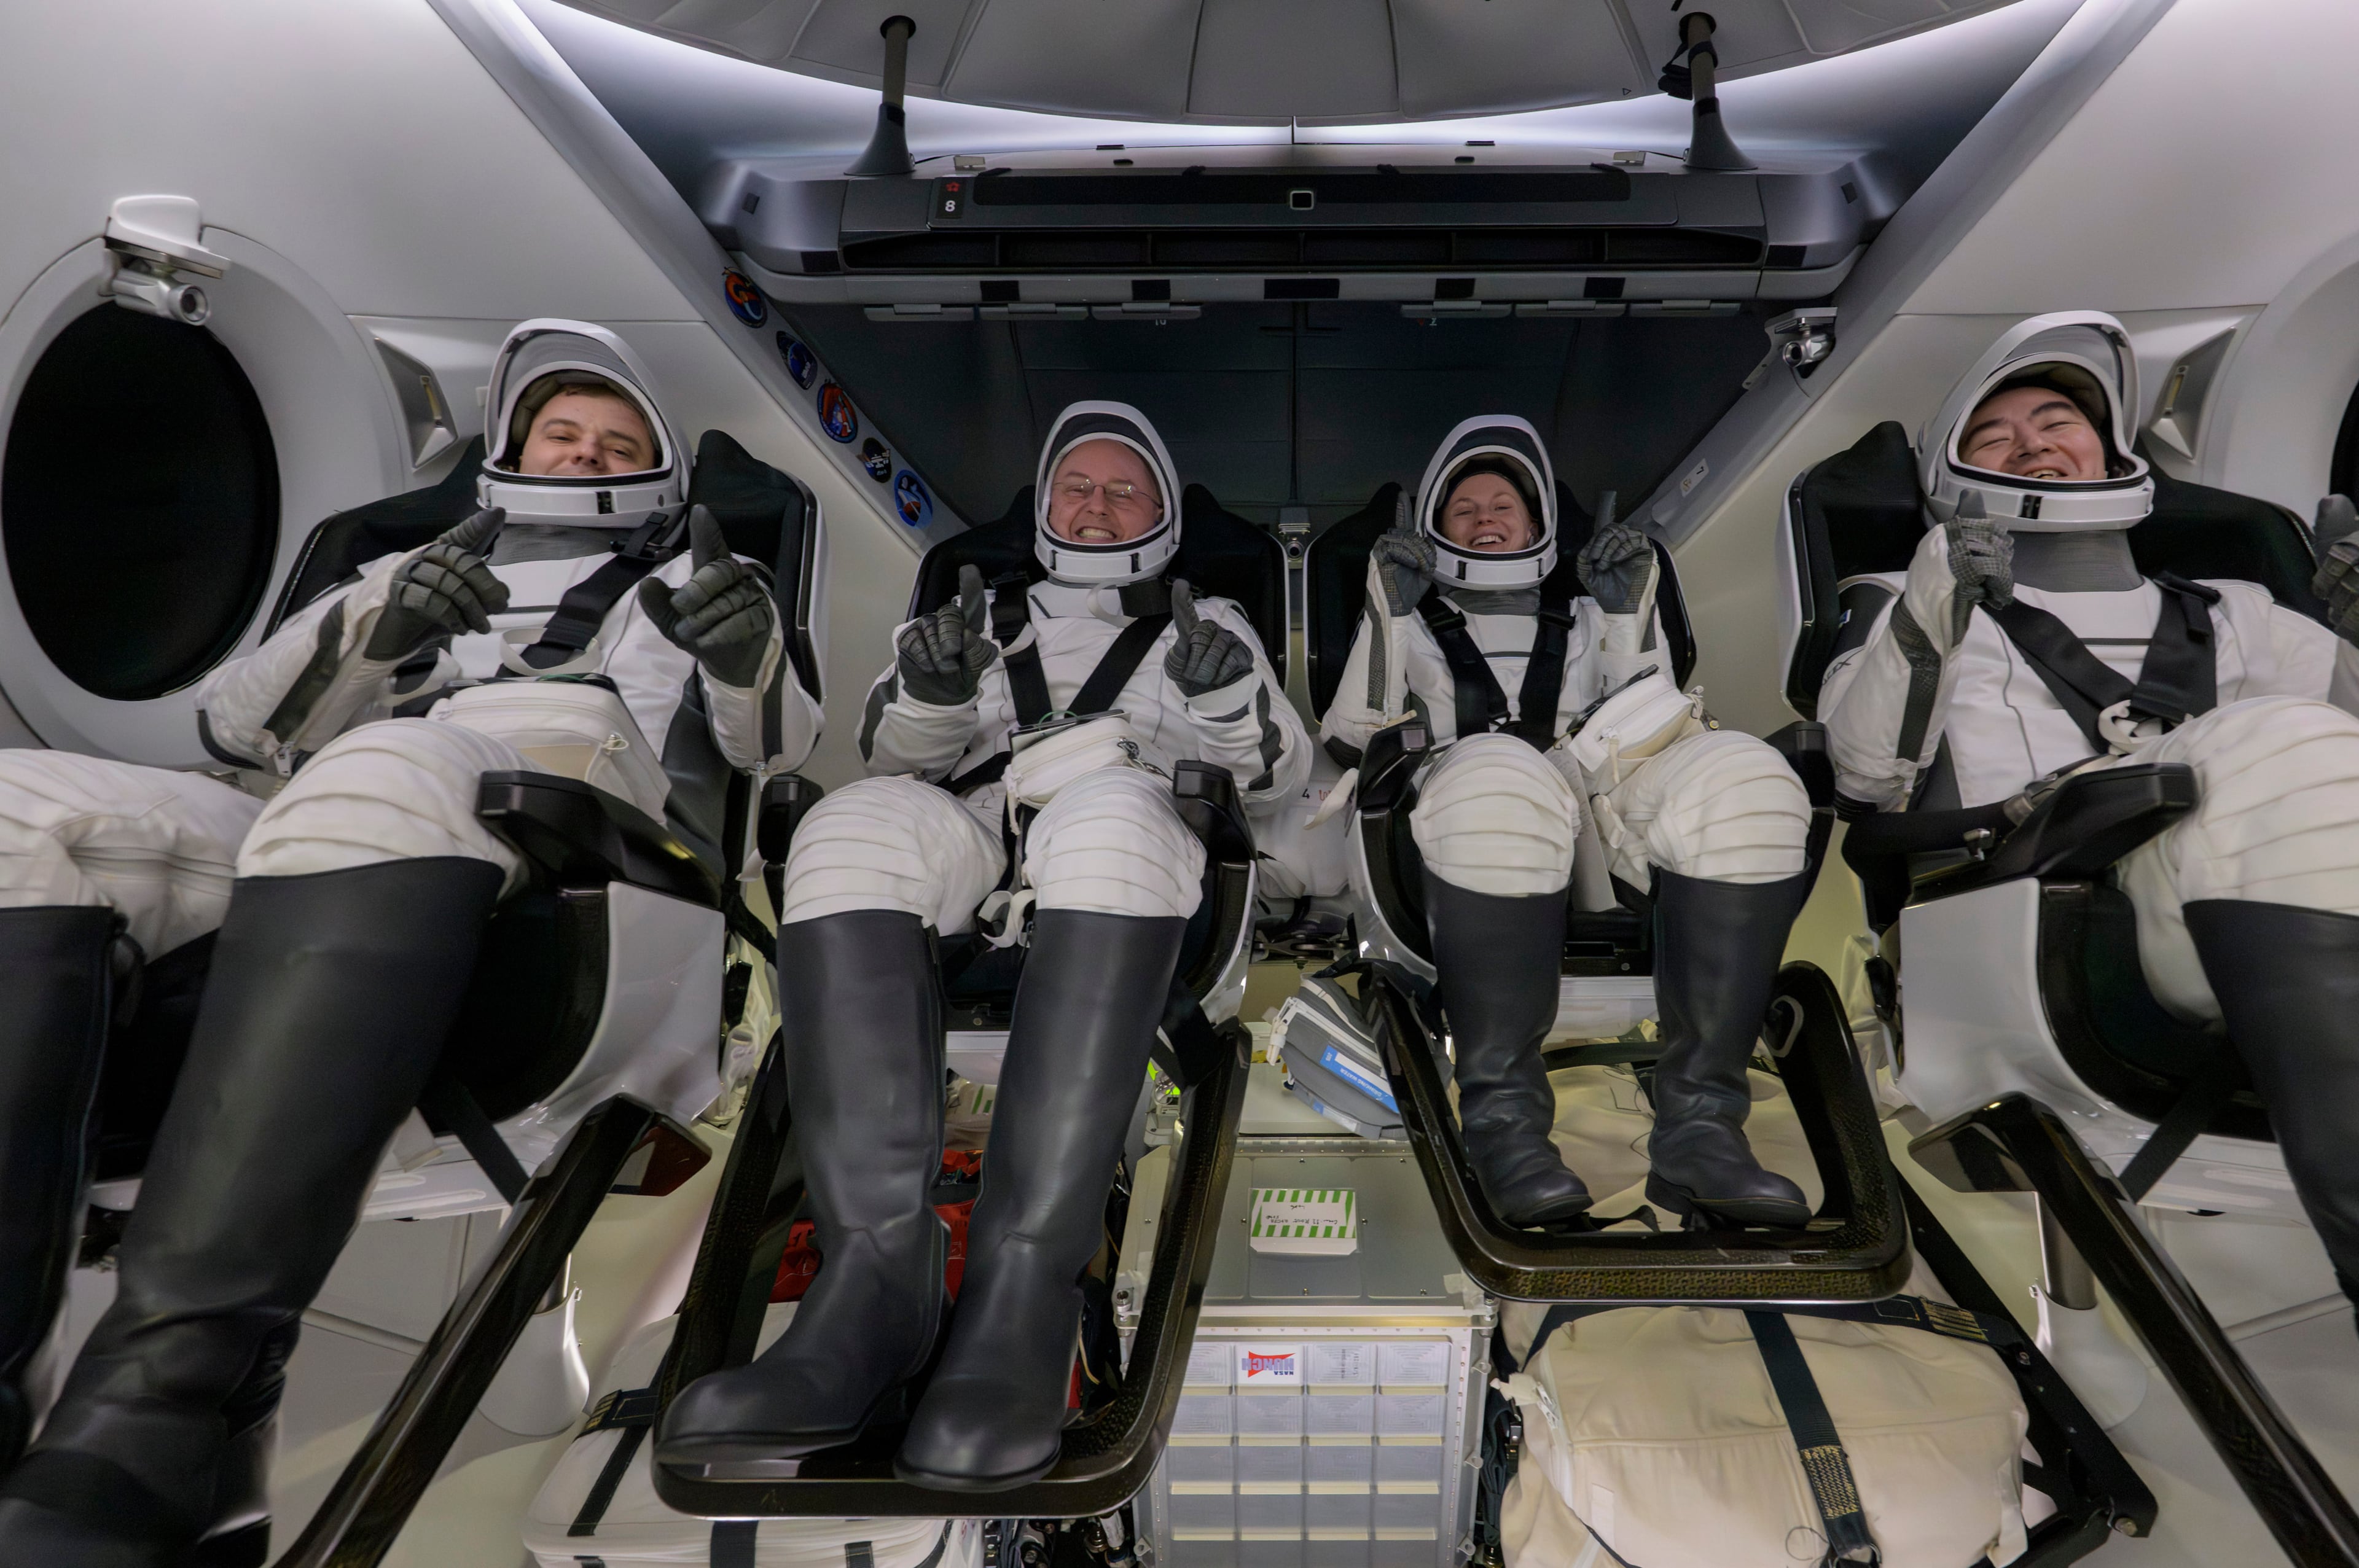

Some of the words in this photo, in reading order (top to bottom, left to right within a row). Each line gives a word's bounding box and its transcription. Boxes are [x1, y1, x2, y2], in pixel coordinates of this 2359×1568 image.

[945, 200, 955, 212] 8
[1302, 788, 1310, 799] 4
[1340, 1068, 1358, 1081] WATER
[1357, 1078, 1382, 1097] DRINKING
[1242, 1358, 1294, 1371] HUNCH
